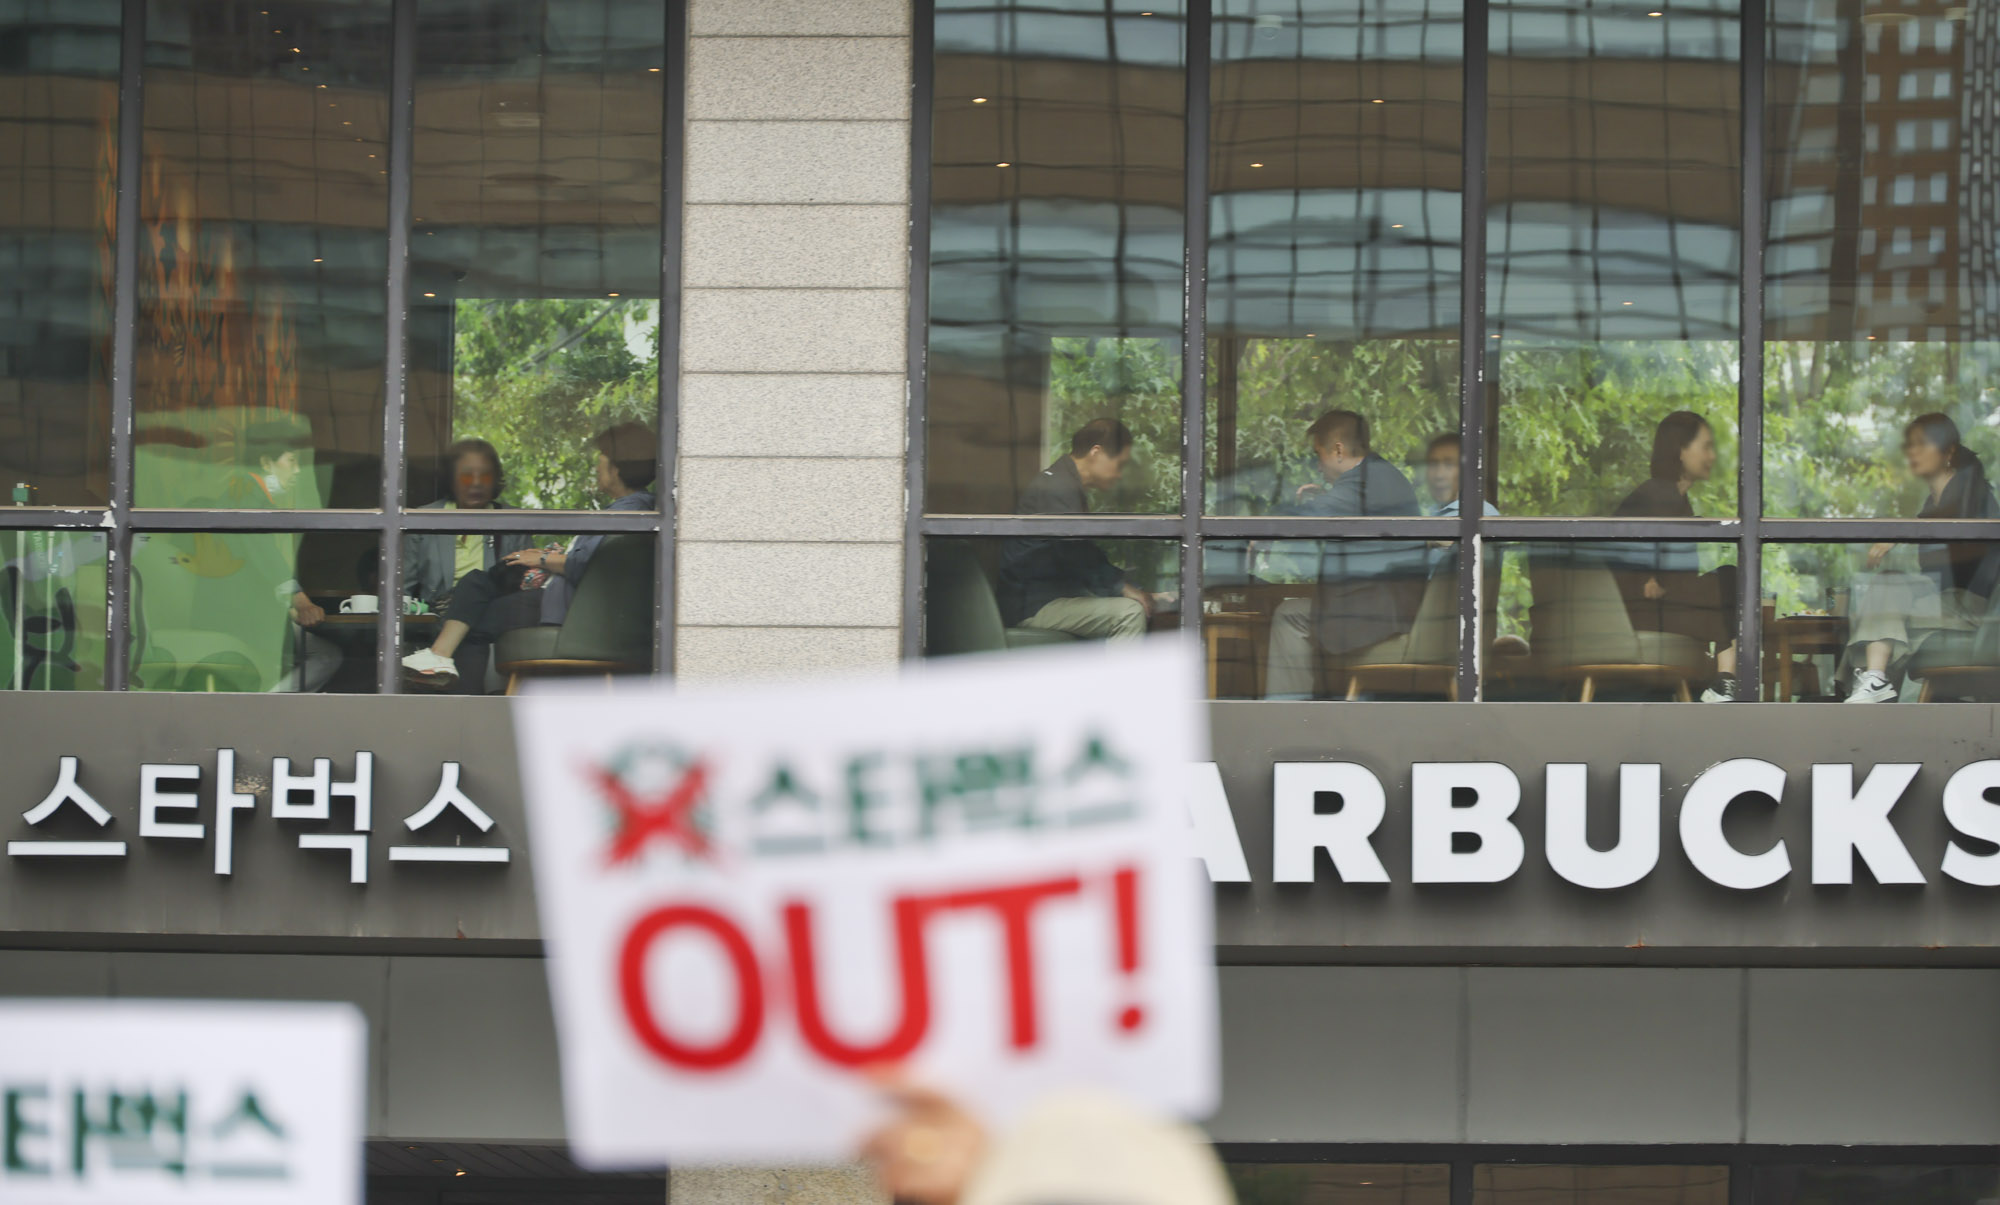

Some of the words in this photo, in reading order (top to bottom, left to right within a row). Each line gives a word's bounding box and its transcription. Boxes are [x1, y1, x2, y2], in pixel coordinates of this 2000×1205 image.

[7, 747, 510, 884] 스타벅스
[747, 727, 1145, 857] 스타벅스
[615, 865, 1145, 1072] OUT!
